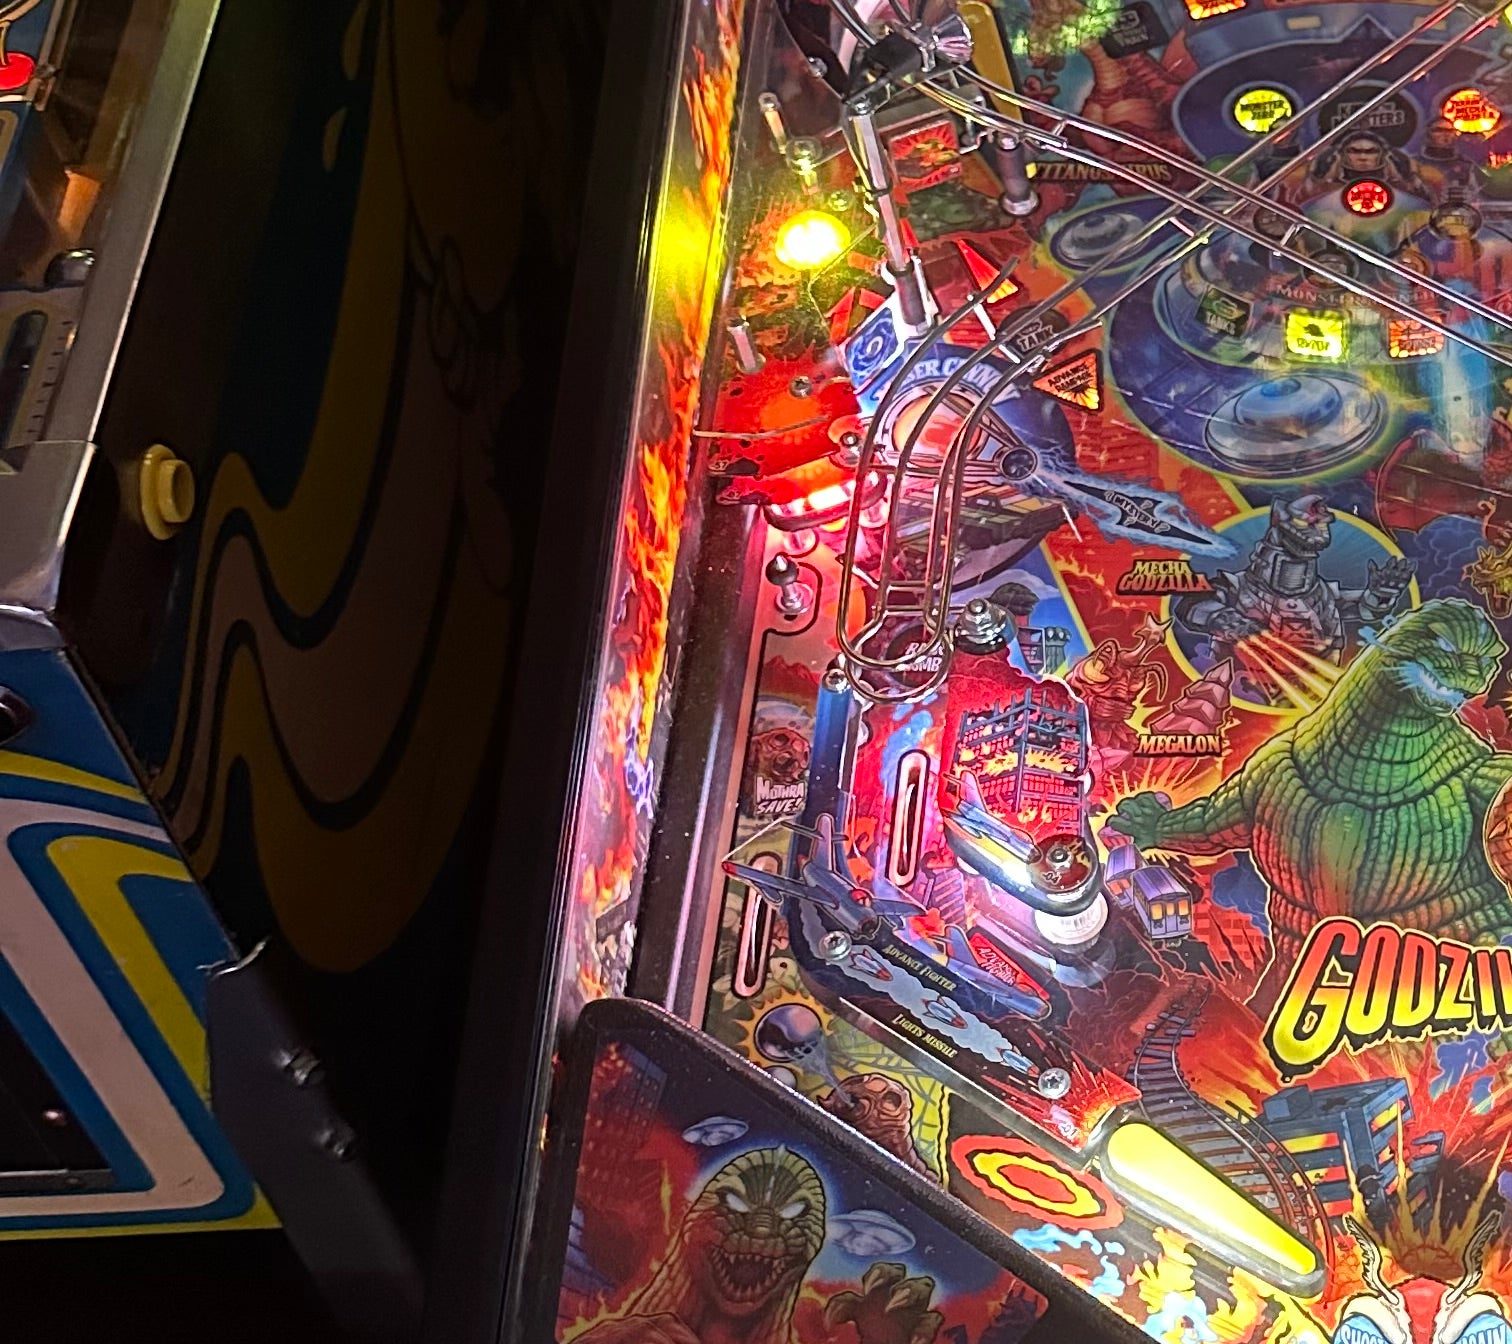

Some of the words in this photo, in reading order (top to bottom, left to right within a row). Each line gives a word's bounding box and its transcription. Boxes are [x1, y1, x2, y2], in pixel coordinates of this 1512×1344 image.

[1114, 494, 1158, 529] MYSTERY
[1132, 561, 1190, 575] MECHA
[1119, 573, 1214, 593] GODZILLA
[1137, 734, 1221, 754] MEGALON
[755, 777, 804, 800] MOTHRA
[757, 798, 804, 814] SAVE!
[892, 1013, 925, 1038] LIGHTS
